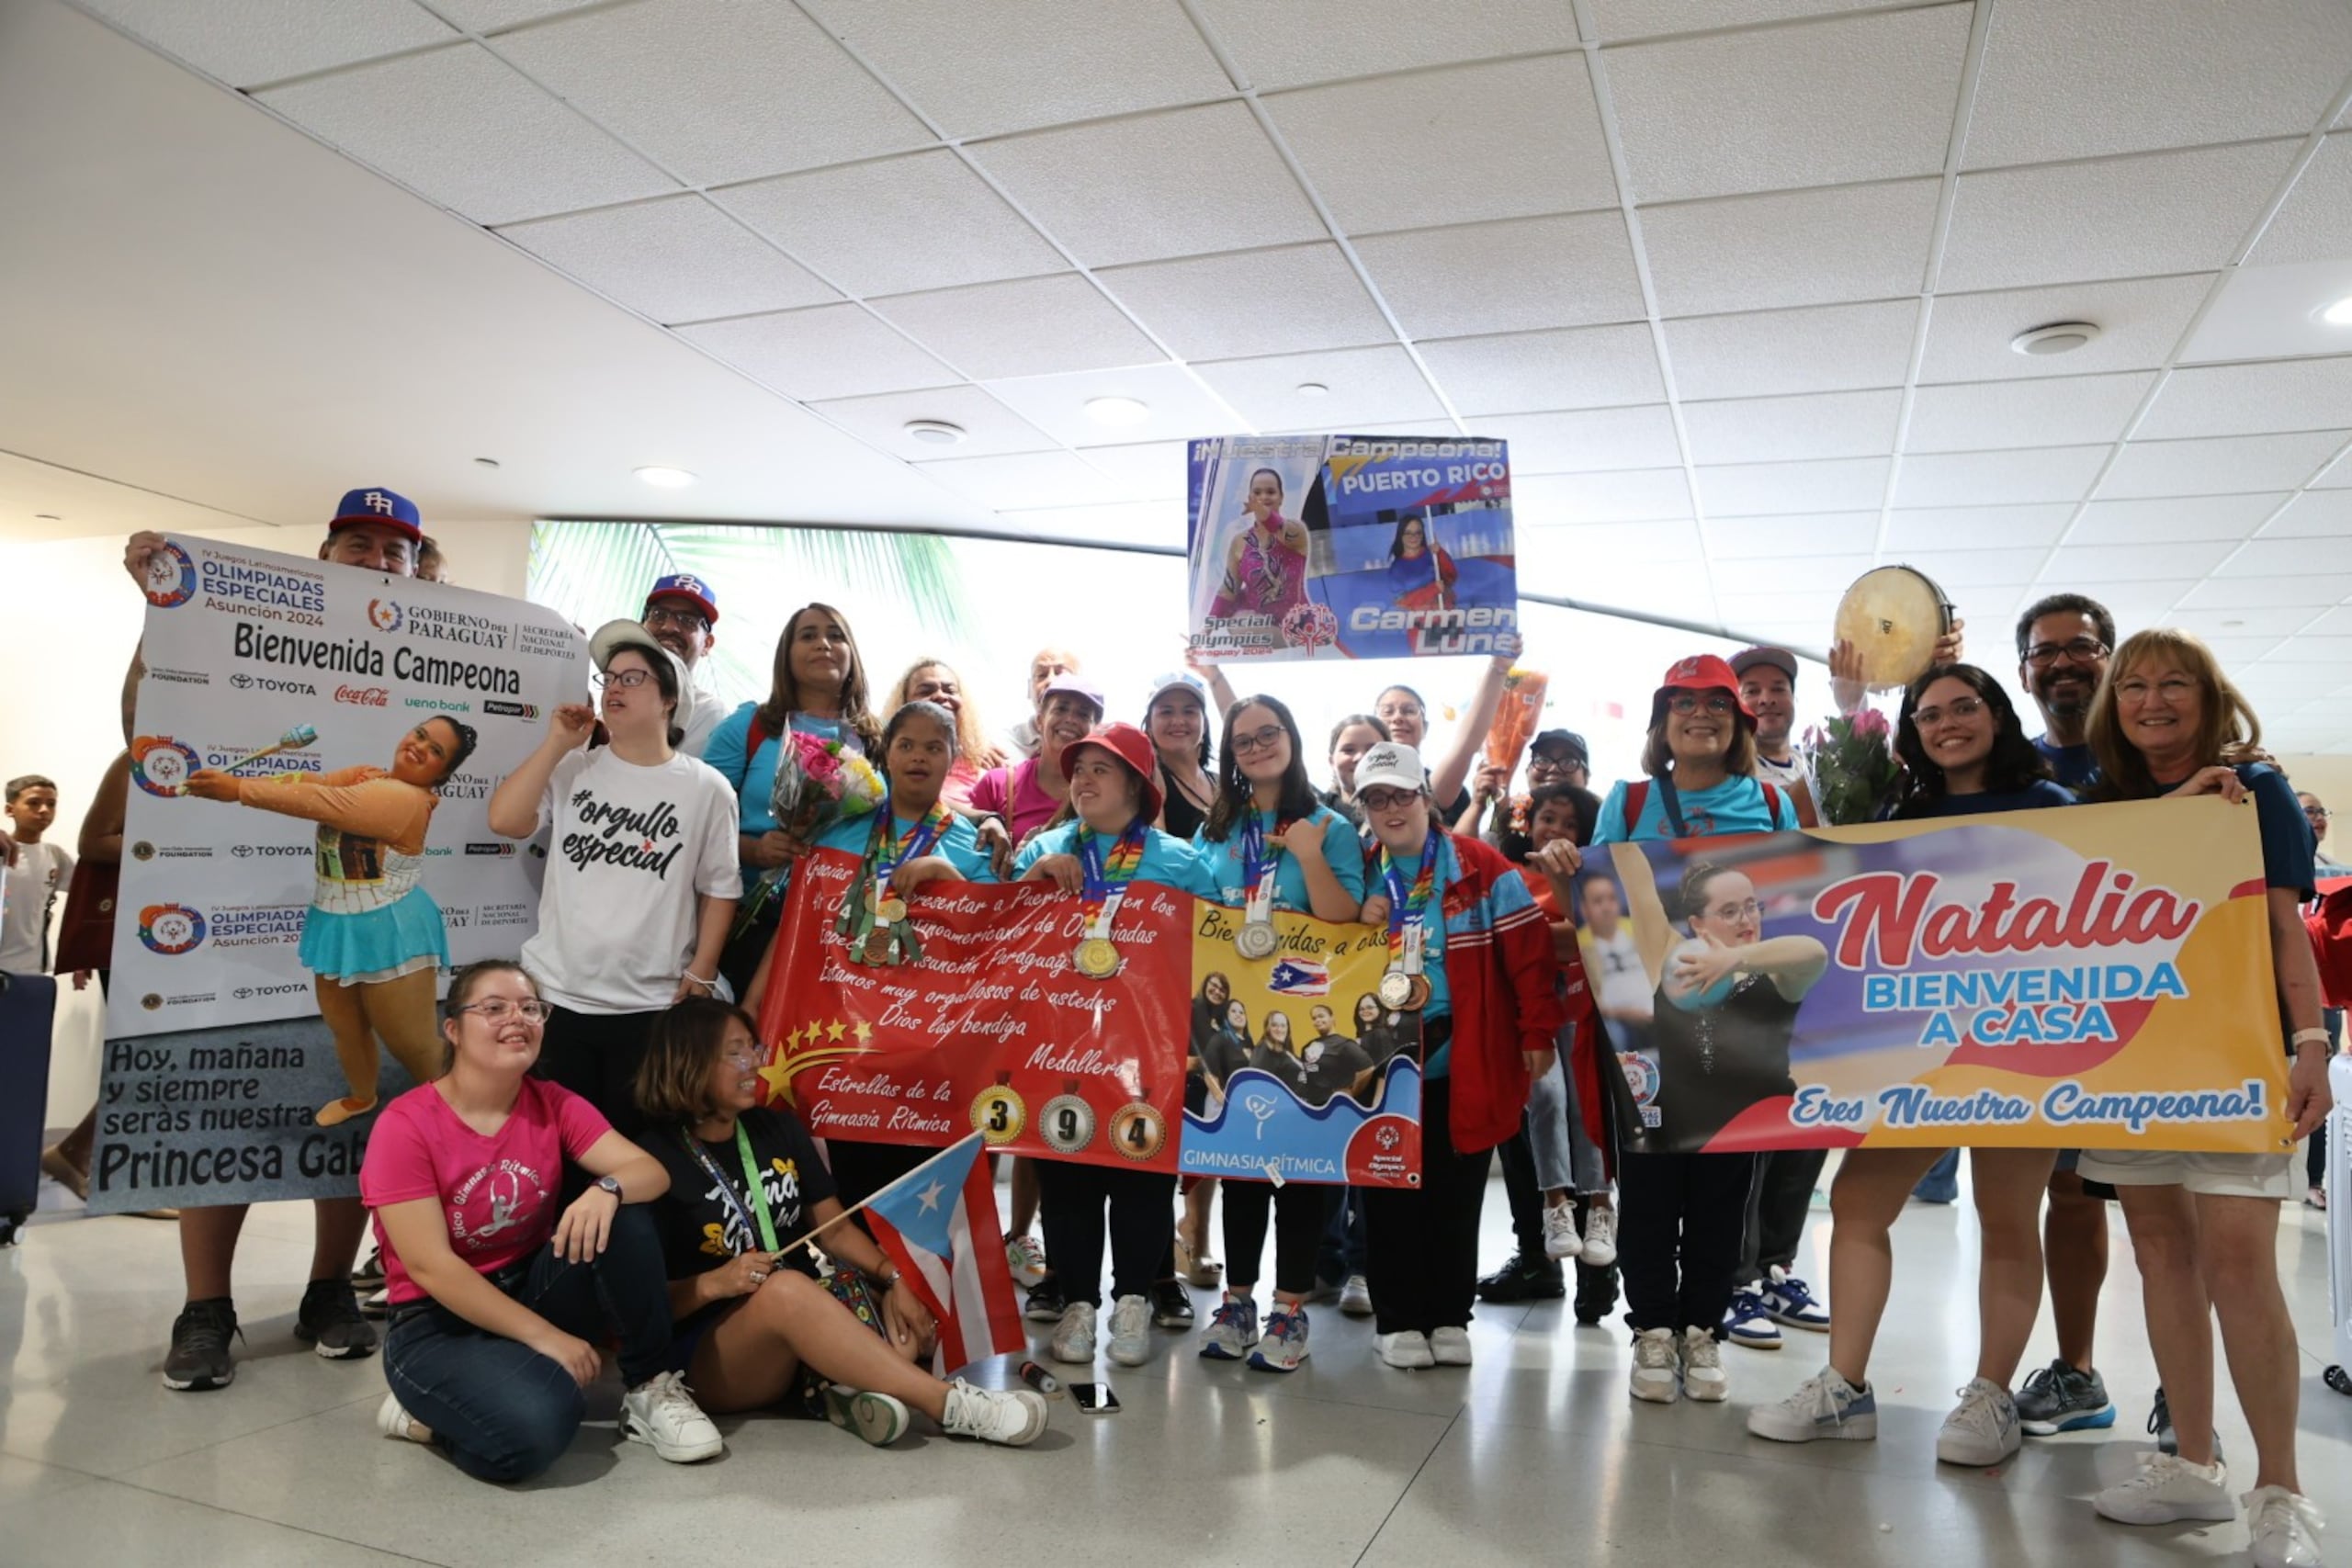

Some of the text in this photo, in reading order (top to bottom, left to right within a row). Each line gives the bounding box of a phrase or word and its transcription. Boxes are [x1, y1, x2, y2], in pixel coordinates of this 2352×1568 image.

[1332, 437, 1502, 460] Campeona!
[1342, 462, 1505, 494] PUERTO RICO
[202, 561, 324, 596] OLIMPIADAS
[203, 578, 324, 612] ESPECIALES
[205, 596, 323, 626] Asunción 2024
[408, 606, 508, 634] GOBIERNO DEL
[1204, 615, 1272, 628] Special
[1351, 606, 1517, 631] Carmen
[409, 620, 507, 649] PARAGUAY
[522, 635, 565, 649] NACIONAL
[1190, 633, 1272, 648] Olympics
[1415, 629, 1518, 654] Luna
[234, 622, 520, 694] Bienvenida Campeona
[520, 644, 575, 660] DE DEPORTES
[152, 672, 209, 685] FOUNDATION
[257, 678, 316, 695] TOYOTA
[404, 697, 470, 714] ueno bank
[571, 789, 680, 842] #orgullo
[256, 845, 313, 857] TOYOTA
[424, 845, 453, 856] bank
[563, 833, 683, 880] especial
[807, 853, 853, 885] Gracias
[994, 899, 1003, 911] a
[1011, 886, 1069, 909] Puerto
[1122, 897, 1145, 910] en
[1151, 892, 1175, 916] los
[1815, 862, 2199, 968] Natalia
[211, 910, 307, 924] OLIMPIADA
[211, 921, 305, 936] ESPECIALE
[212, 934, 279, 947] Asunción
[1335, 942, 1348, 955] a
[256, 983, 309, 996] TOYOTA
[820, 956, 876, 989] Estamos
[880, 984, 918, 1006] muy
[1020, 978, 1040, 1001] de
[1048, 988, 1117, 1012] ustedes
[1866, 961, 2186, 1010] BIENVENIDA
[878, 1002, 922, 1030] Dios
[961, 1010, 1026, 1043] bendiga
[1921, 1005, 2114, 1044] A CASA
[109, 1041, 304, 1074] Hoy, mañana
[1024, 1043, 1125, 1077] Medallero
[106, 1075, 260, 1104] y siempre
[818, 1066, 952, 1101] Estrellas de la
[200, 1103, 313, 1131] nuestra
[809, 1099, 952, 1134] Gimnasia Rítmica
[1793, 1083, 2265, 1131] Eres Nuestra Campeona!
[989, 1100, 1147, 1149] 3 9 4
[98, 1140, 282, 1191] Princesa
[1183, 1149, 1266, 1169] GIMNASIA
[1272, 1153, 1336, 1174] RÍTMICA
